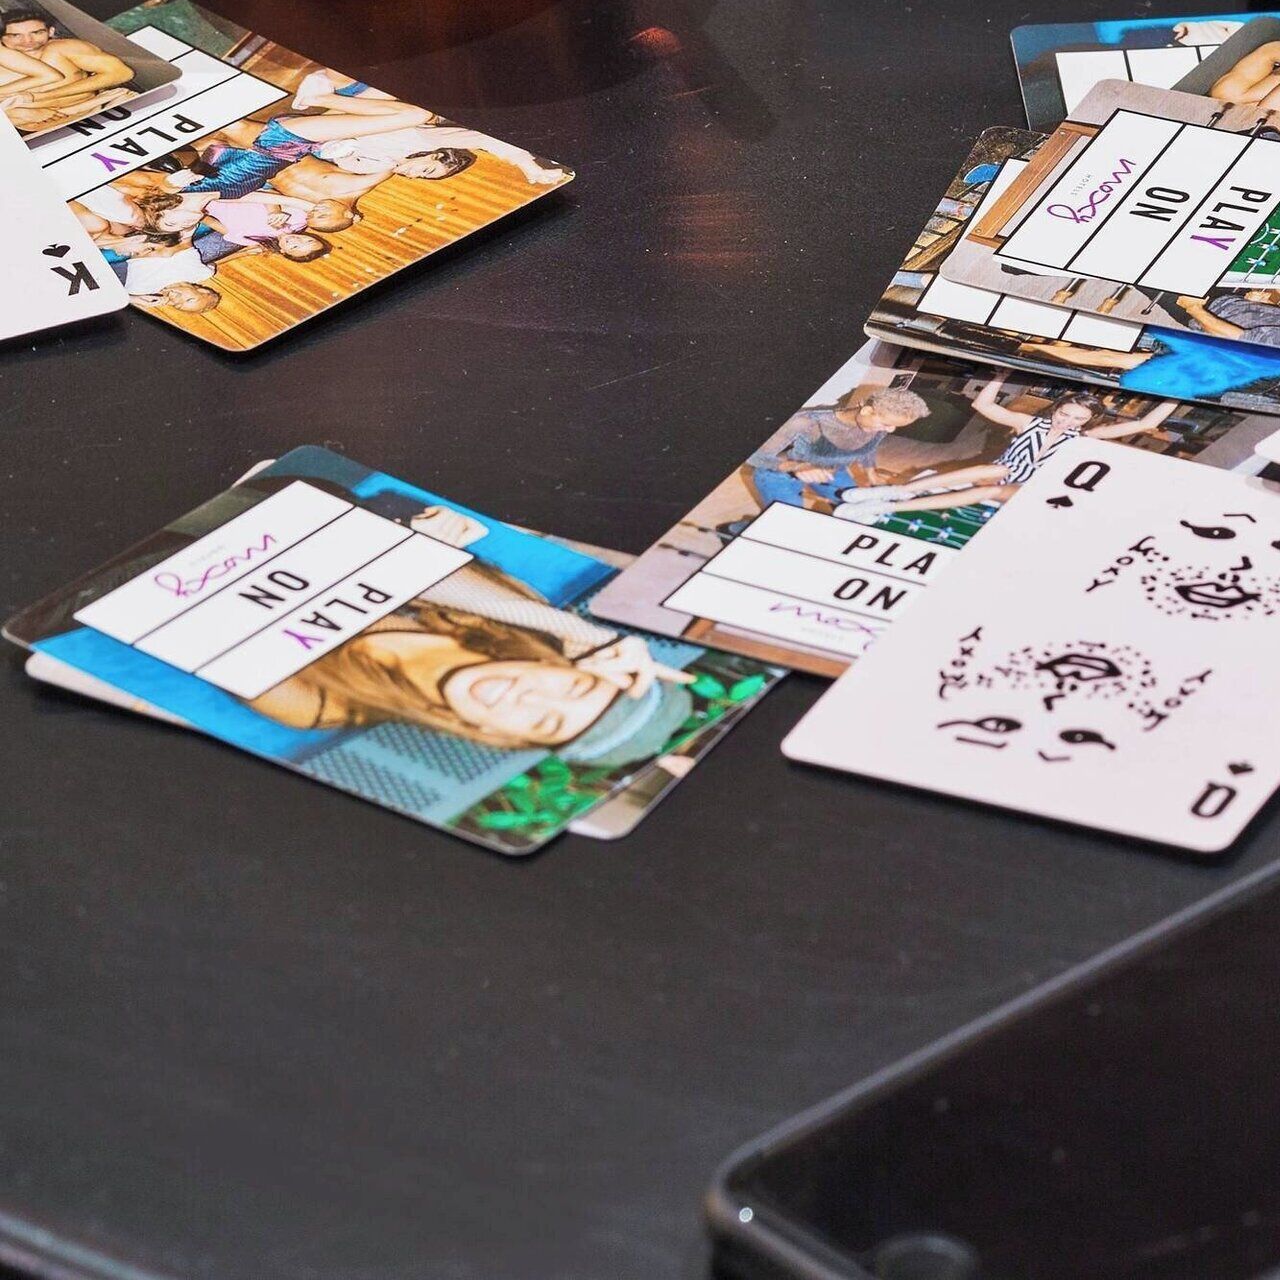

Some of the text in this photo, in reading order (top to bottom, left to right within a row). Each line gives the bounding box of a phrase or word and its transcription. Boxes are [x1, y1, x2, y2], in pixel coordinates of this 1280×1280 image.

[90, 113, 205, 173] PLAY
[1129, 186, 1191, 222] ON
[1190, 186, 1273, 251] PLAY
[50, 261, 100, 297] K
[1063, 460, 1112, 493] Q
[841, 533, 938, 576] PLA
[238, 570, 309, 610] ON
[833, 578, 908, 611] ON
[282, 582, 394, 650] PLAY
[1190, 781, 1237, 819] Q
